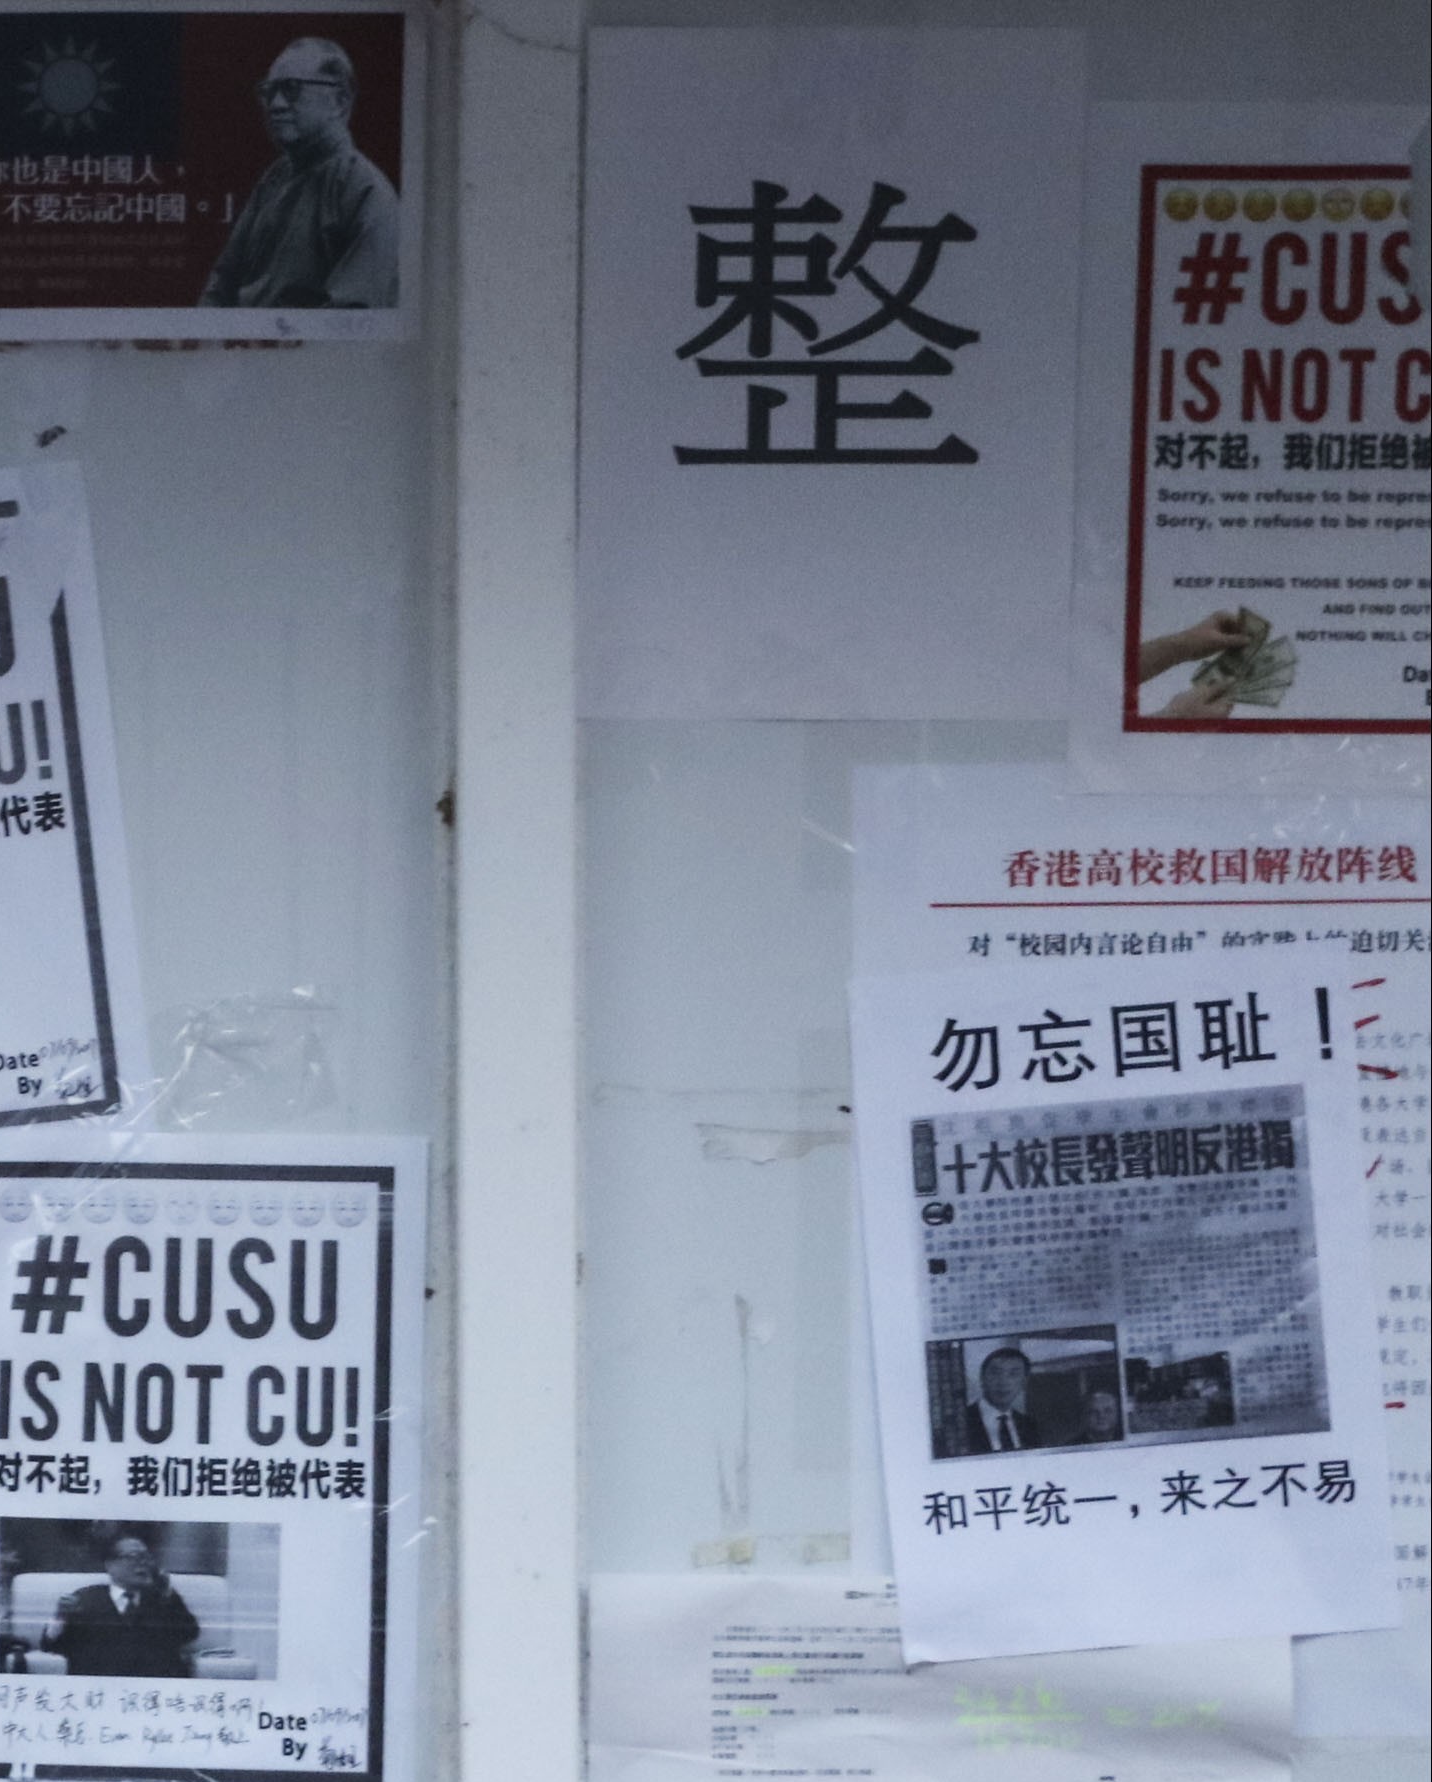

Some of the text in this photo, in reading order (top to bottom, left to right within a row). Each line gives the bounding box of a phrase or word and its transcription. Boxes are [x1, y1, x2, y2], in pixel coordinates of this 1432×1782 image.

[673, 181, 980, 466] 整
[1158, 348, 1376, 423] IS NOT
[1156, 515, 1368, 530] Sorry, we refuse to be
[1157, 489, 1371, 504] Sorry, we refuse to be
[1290, 577, 1340, 588] THOSE
[1347, 577, 1388, 588] SONS
[1393, 577, 1412, 588] OF
[1004, 845, 1418, 888] 香港高校救国解放阵线
[931, 986, 1334, 1093] 勿忘国耻！
[17, 1076, 41, 1097] By
[942, 1118, 1296, 1195] 十大校長發聲明反港獨
[11, 1235, 339, 1340] #CUSU
[82, 1363, 223, 1444] NOT
[246, 1365, 361, 1448] CU!
[923, 1457, 1358, 1537] 和平统一，来之不易
[259, 1712, 306, 1731] Date
[283, 1739, 306, 1760] By
